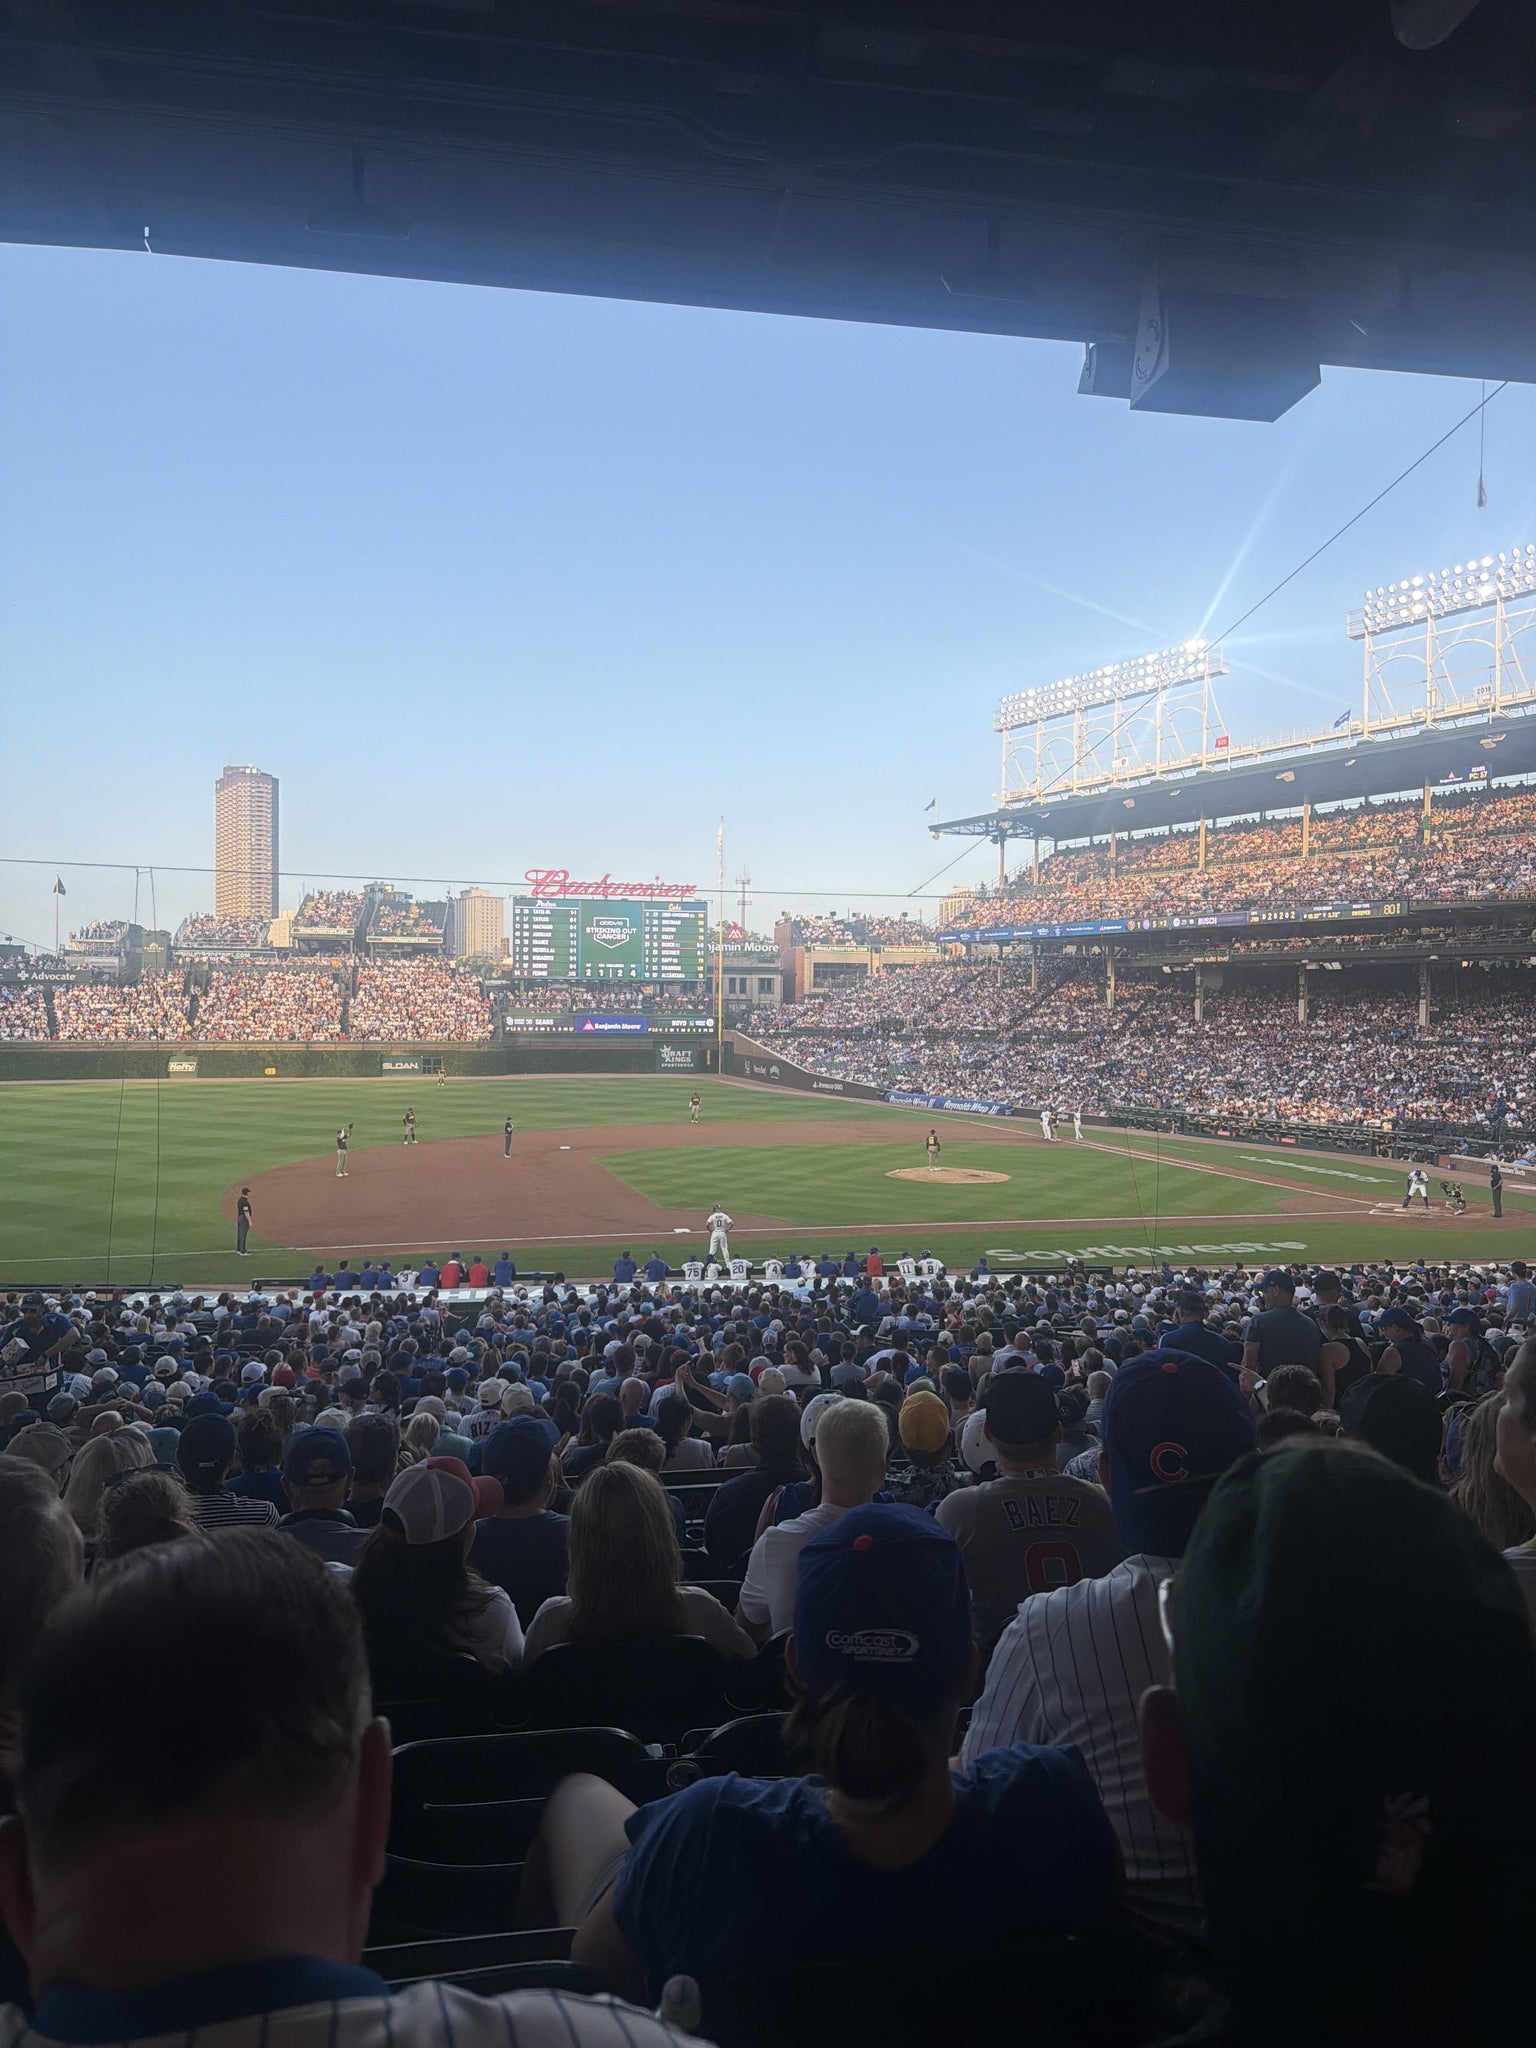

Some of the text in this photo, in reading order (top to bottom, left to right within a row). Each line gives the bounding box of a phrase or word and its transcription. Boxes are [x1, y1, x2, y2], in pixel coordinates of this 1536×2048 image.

[1480, 771, 1488, 779] 57
[525, 869, 697, 898] Budweiser
[1383, 904, 1395, 914] 80
[1137, 920, 1140, 929] 1
[1152, 919, 1157, 928] 5
[1198, 917, 1217, 925] BUSCH
[744, 942, 779, 952] Moore
[31, 972, 76, 981] Advocate
[617, 969, 623, 977] 2
[594, 1023, 621, 1031] Benjamin
[662, 1050, 692, 1058] DRAFT
[169, 1062, 195, 1071] Hefty
[819, 1082, 834, 1090] Invesco
[889, 1095, 928, 1108] Reynolds Wrap
[943, 1100, 989, 1114] Reynolds Wrap
[716, 1219, 722, 1228] 0
[985, 1241, 1273, 1261] Southwest
[732, 1264, 744, 1274] 20
[771, 1265, 778, 1274] 4
[804, 1262, 810, 1270] 7
[901, 1264, 911, 1274] 11
[927, 1265, 934, 1274] 8
[687, 1267, 699, 1278] 75
[470, 1421, 498, 1438] RIZ
[1149, 1441, 1190, 1483] C
[1002, 1498, 1085, 1531] BAEZ
[841, 1646, 905, 1656] SPORTSNET
